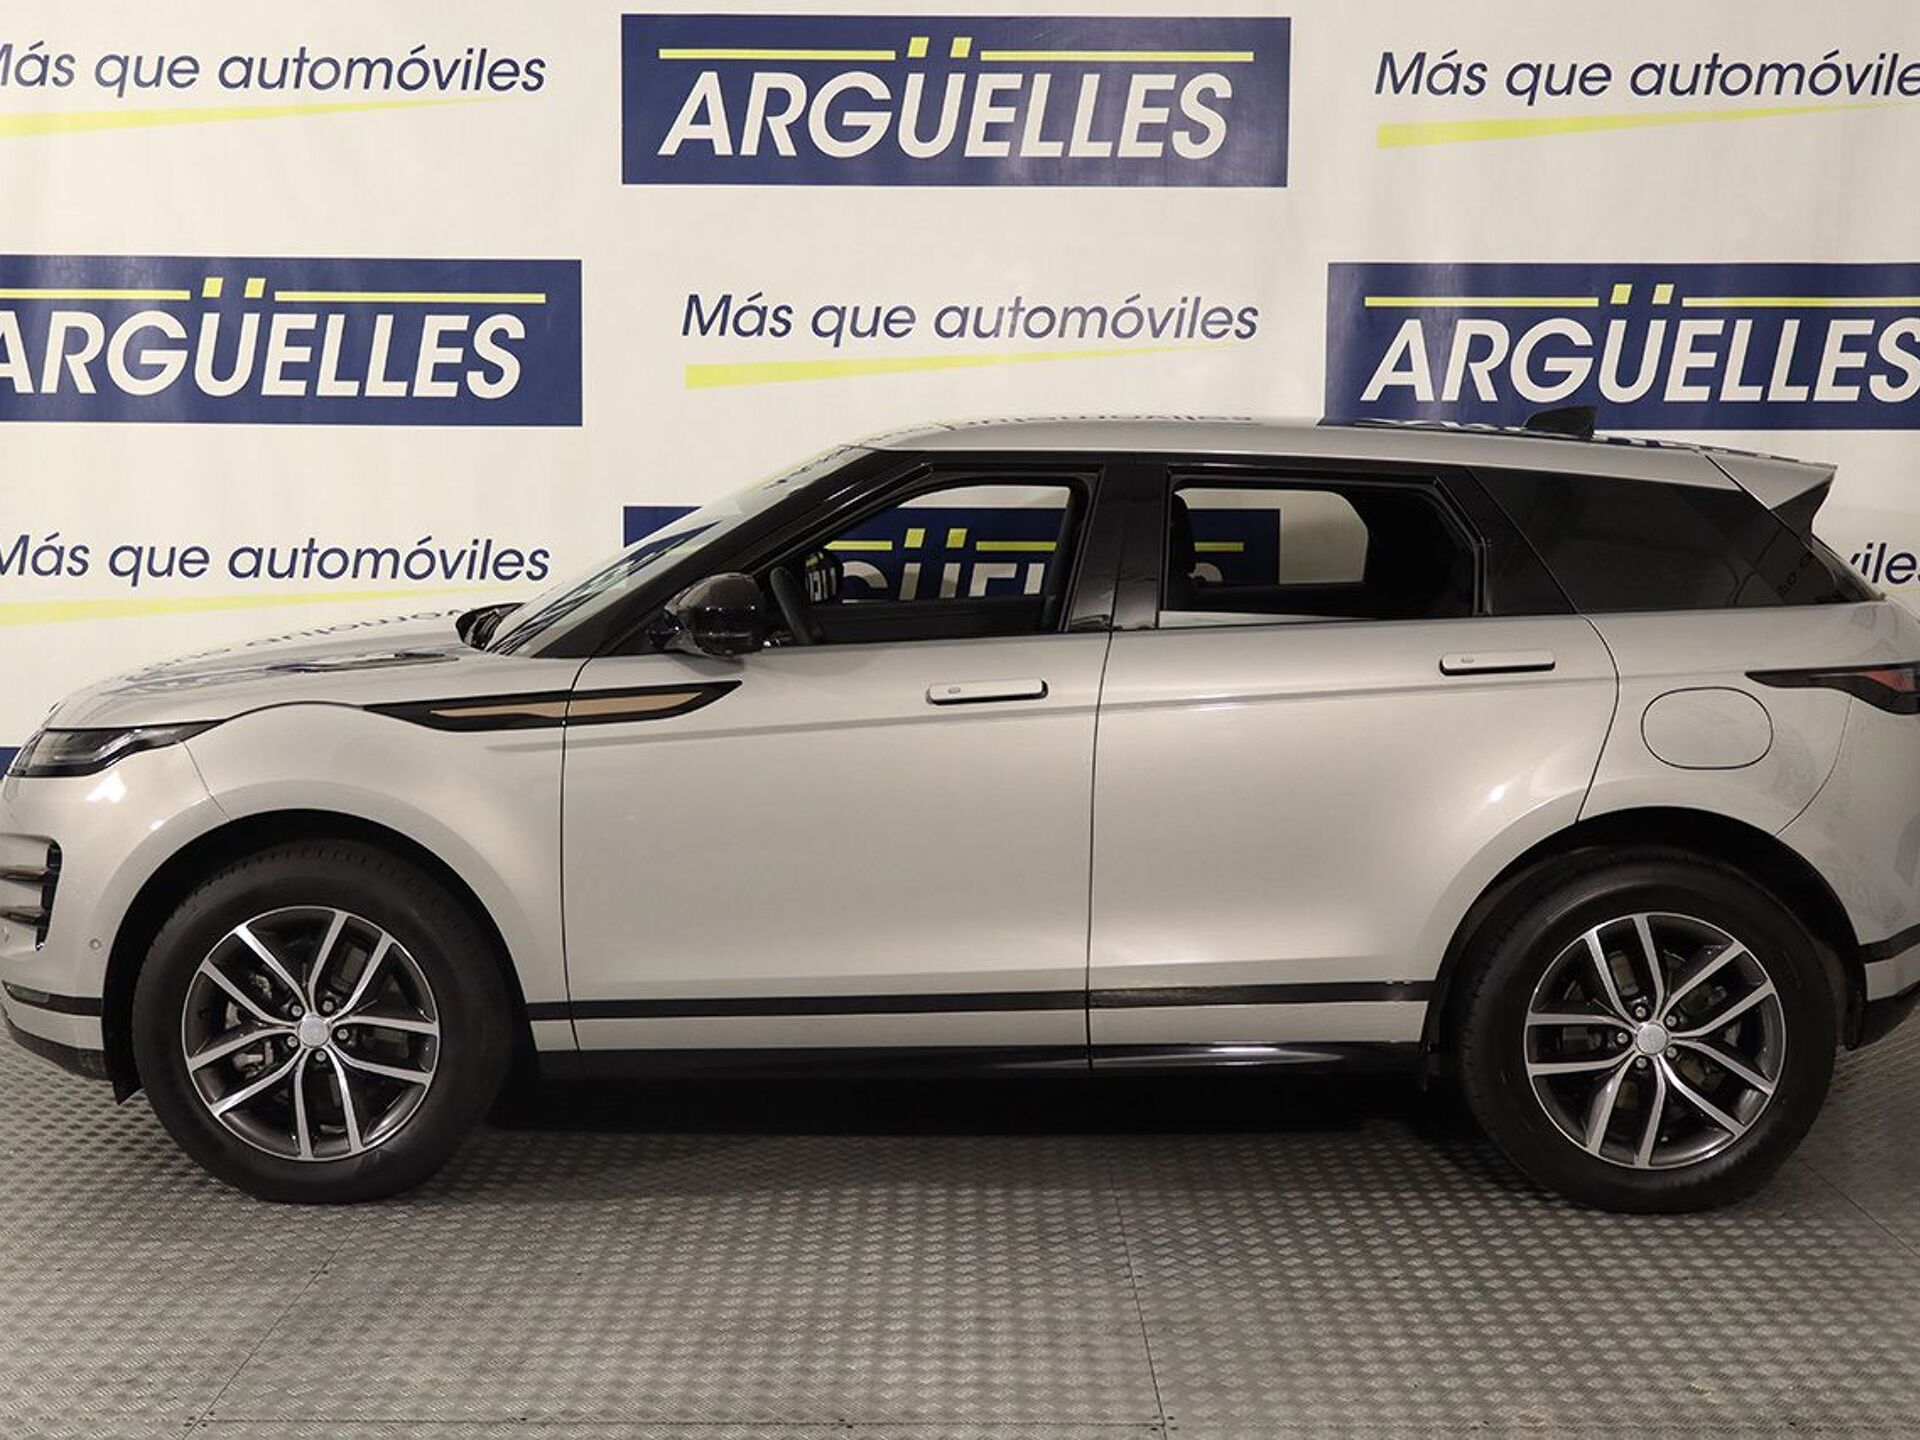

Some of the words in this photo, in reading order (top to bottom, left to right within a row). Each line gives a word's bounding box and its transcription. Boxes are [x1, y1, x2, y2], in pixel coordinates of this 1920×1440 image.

[95, 54, 199, 98] que
[219, 44, 547, 92] automóviles
[658, 37, 1233, 159] ARGÜELLES
[1375, 49, 1488, 96] Más
[1506, 63, 1613, 106] que
[682, 291, 794, 339] Más
[811, 305, 916, 349] que
[934, 294, 1259, 340] automóviles
[1361, 284, 1920, 403] ARGÜELLES
[109, 545, 210, 587] que
[228, 535, 550, 582] automóviles
